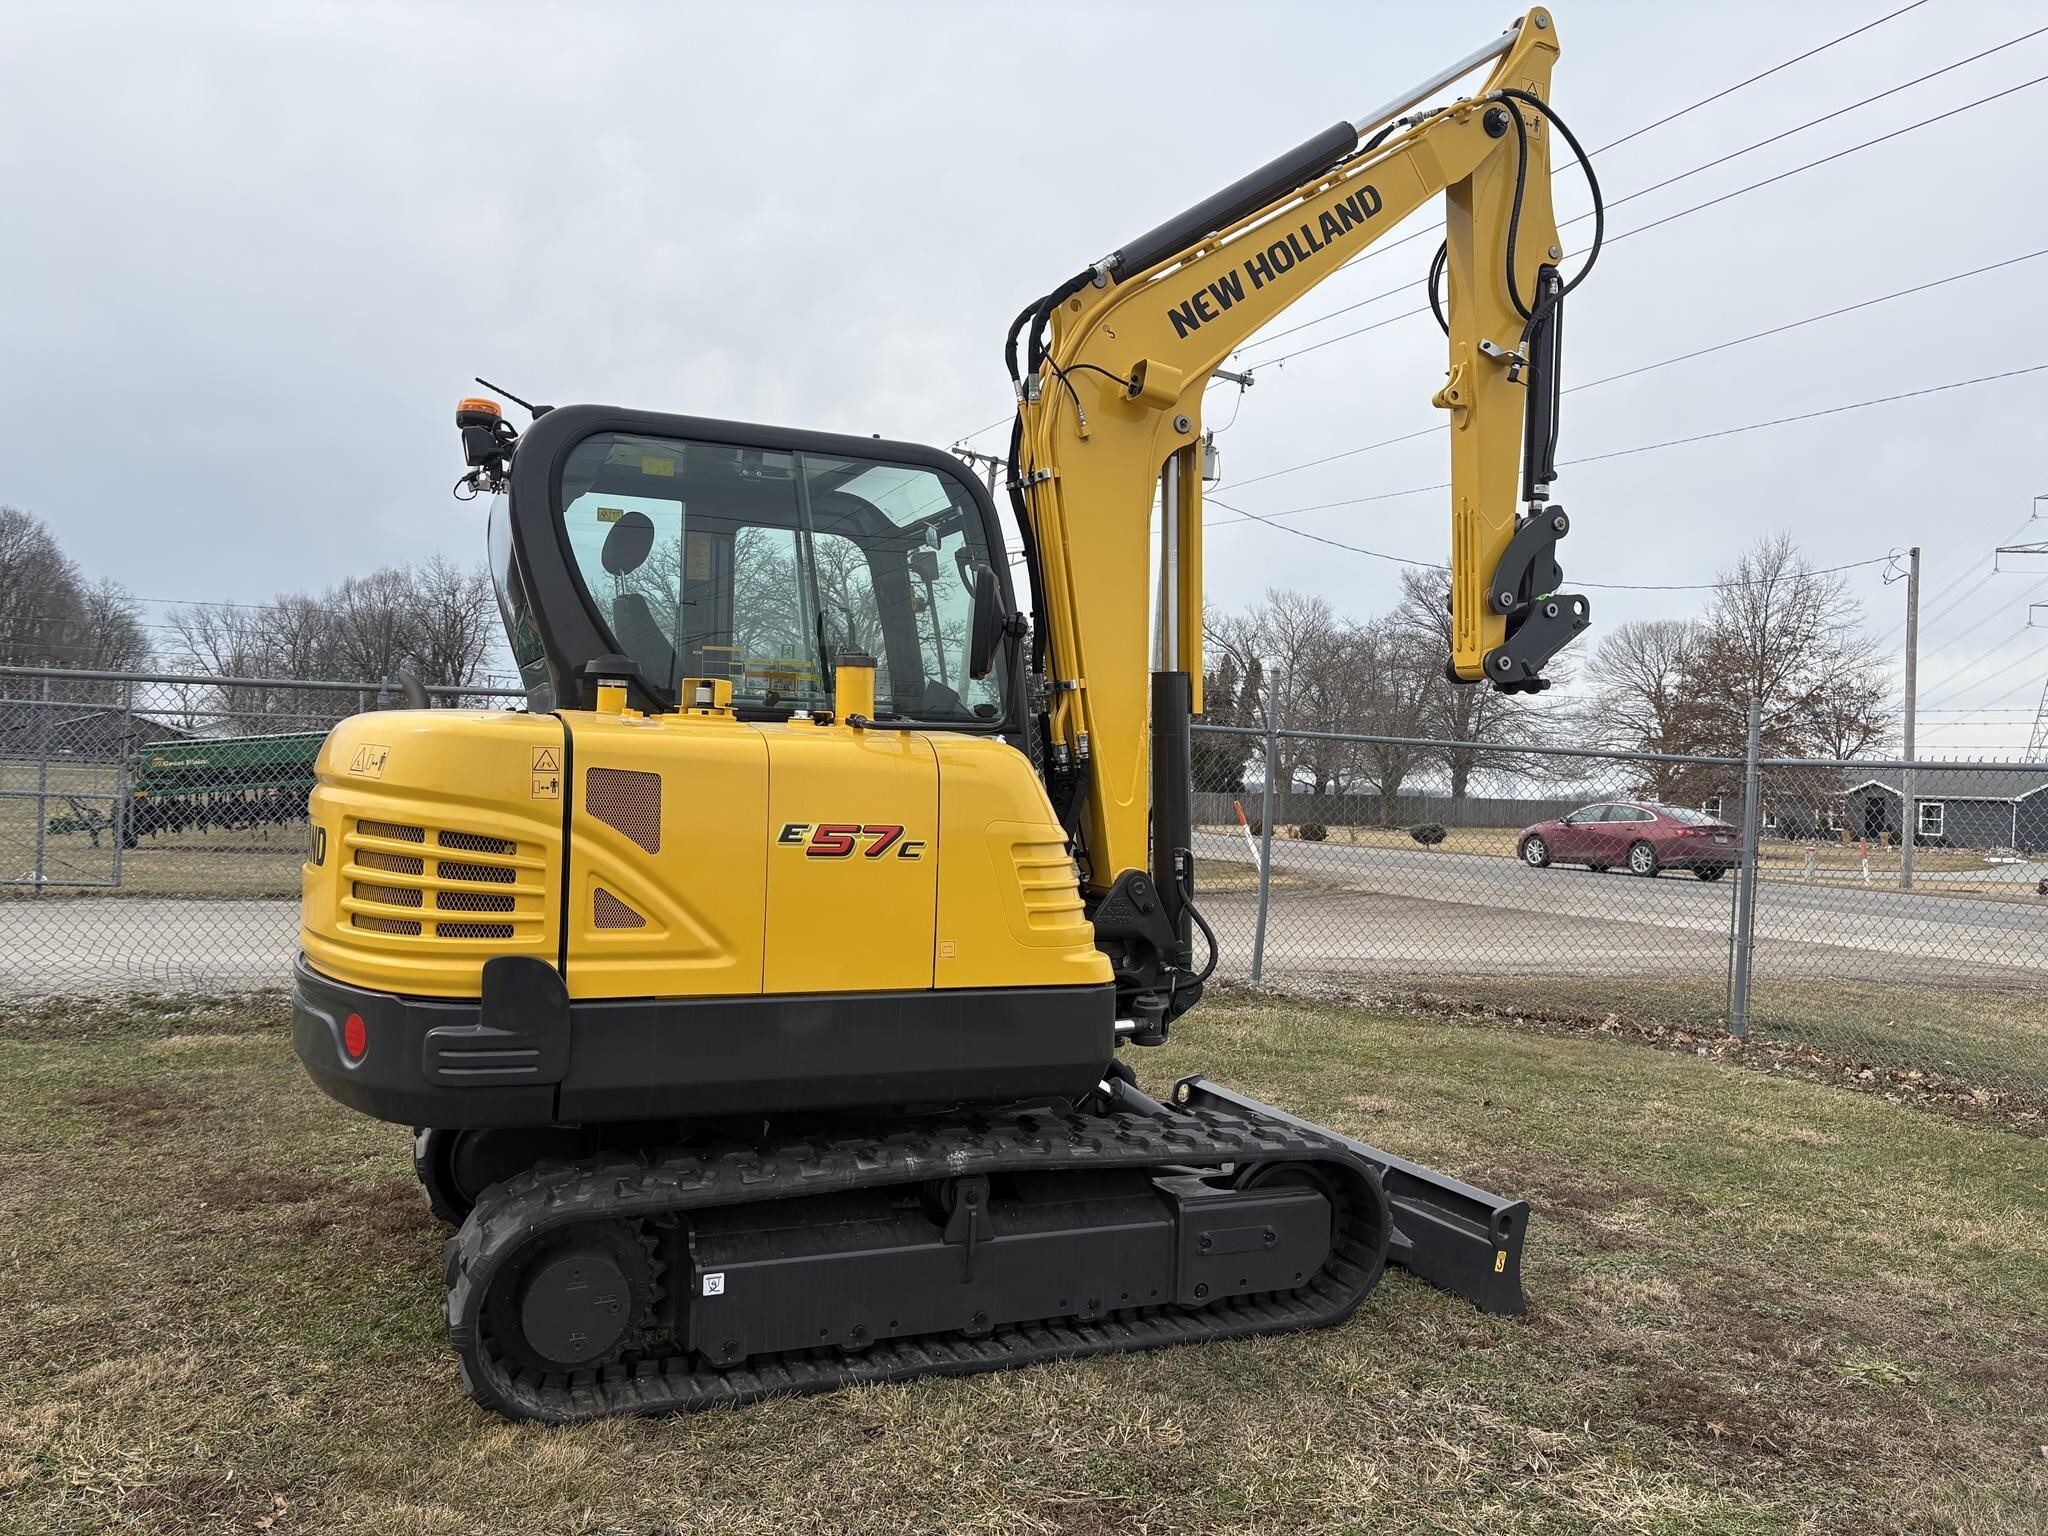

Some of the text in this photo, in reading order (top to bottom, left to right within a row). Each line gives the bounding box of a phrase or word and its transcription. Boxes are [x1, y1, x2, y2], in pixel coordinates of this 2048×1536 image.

[1167, 184, 1383, 340] NEW HOLLAND
[778, 823, 926, 858] E57C
